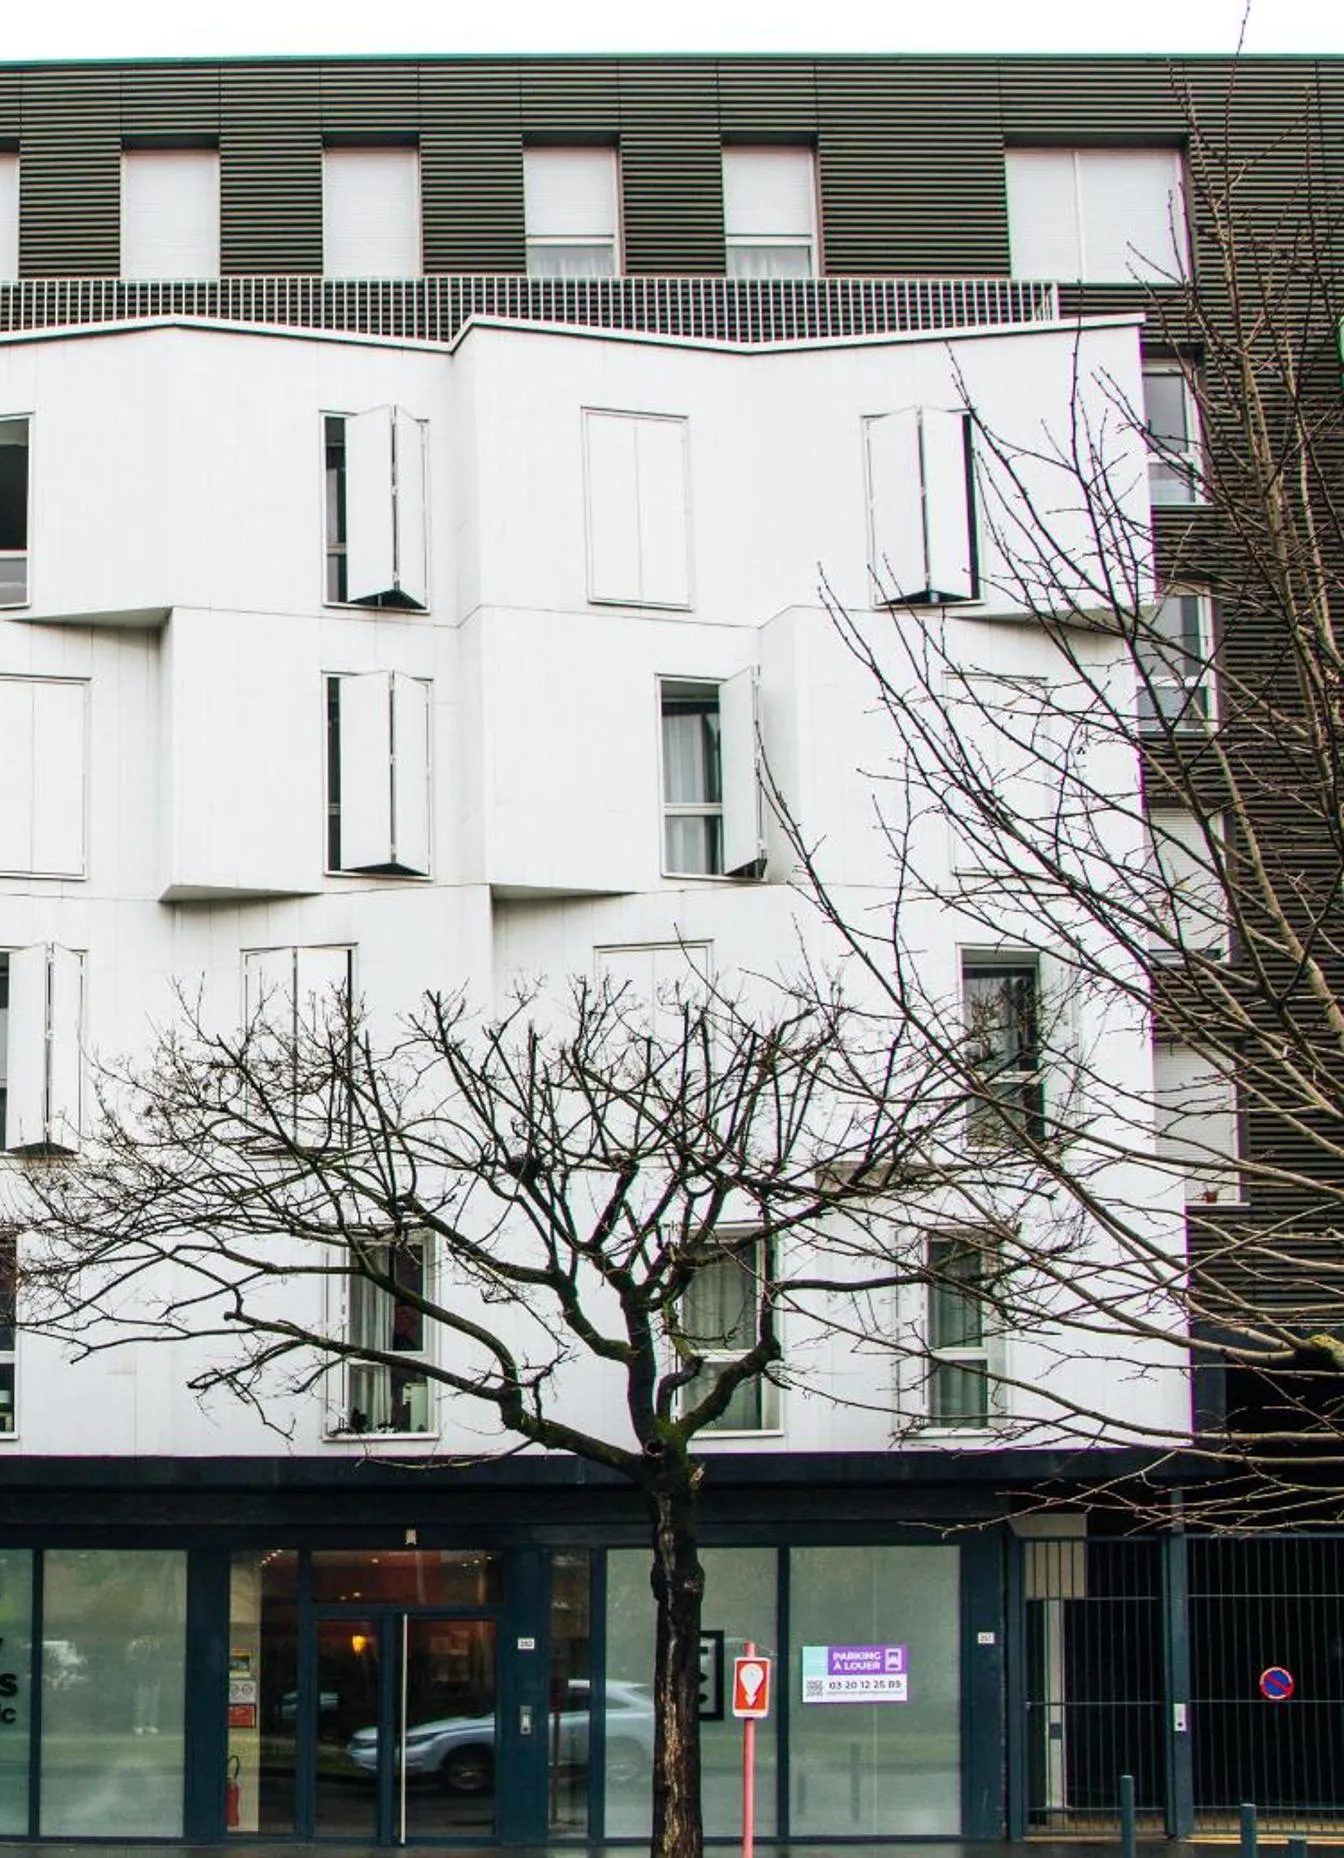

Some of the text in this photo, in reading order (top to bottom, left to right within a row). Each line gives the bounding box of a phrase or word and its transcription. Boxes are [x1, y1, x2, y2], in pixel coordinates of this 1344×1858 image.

[833, 1651, 881, 1660] PARKING
[844, 1661, 881, 1671] LOUER
[829, 1682, 842, 1690] 03
